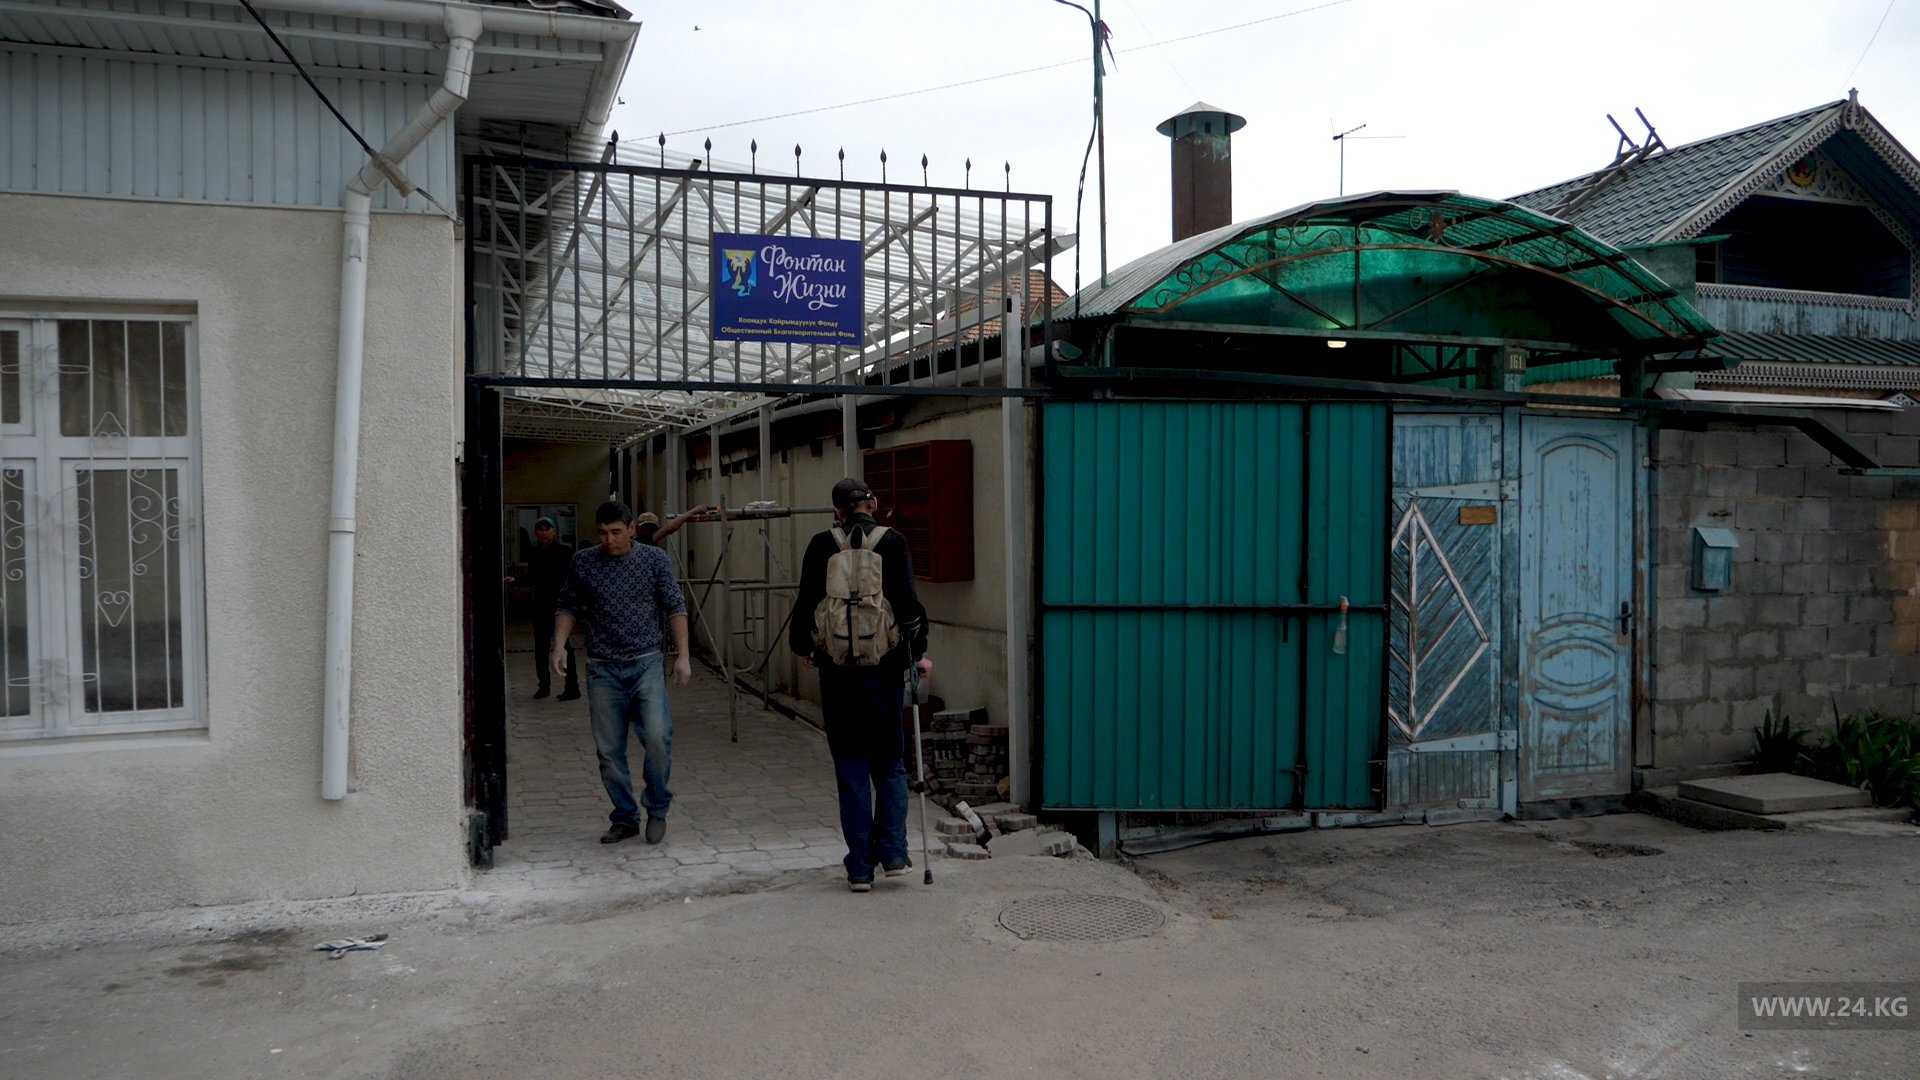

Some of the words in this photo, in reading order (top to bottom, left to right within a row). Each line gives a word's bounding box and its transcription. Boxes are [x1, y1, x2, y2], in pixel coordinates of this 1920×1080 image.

[760, 244, 847, 278] Фонтан
[773, 271, 847, 311] Жизни
[721, 326, 772, 335] Общественный
[773, 328, 837, 337] Благотворительный
[738, 317, 768, 325] Коомдук
[817, 320, 839, 328] Фонду
